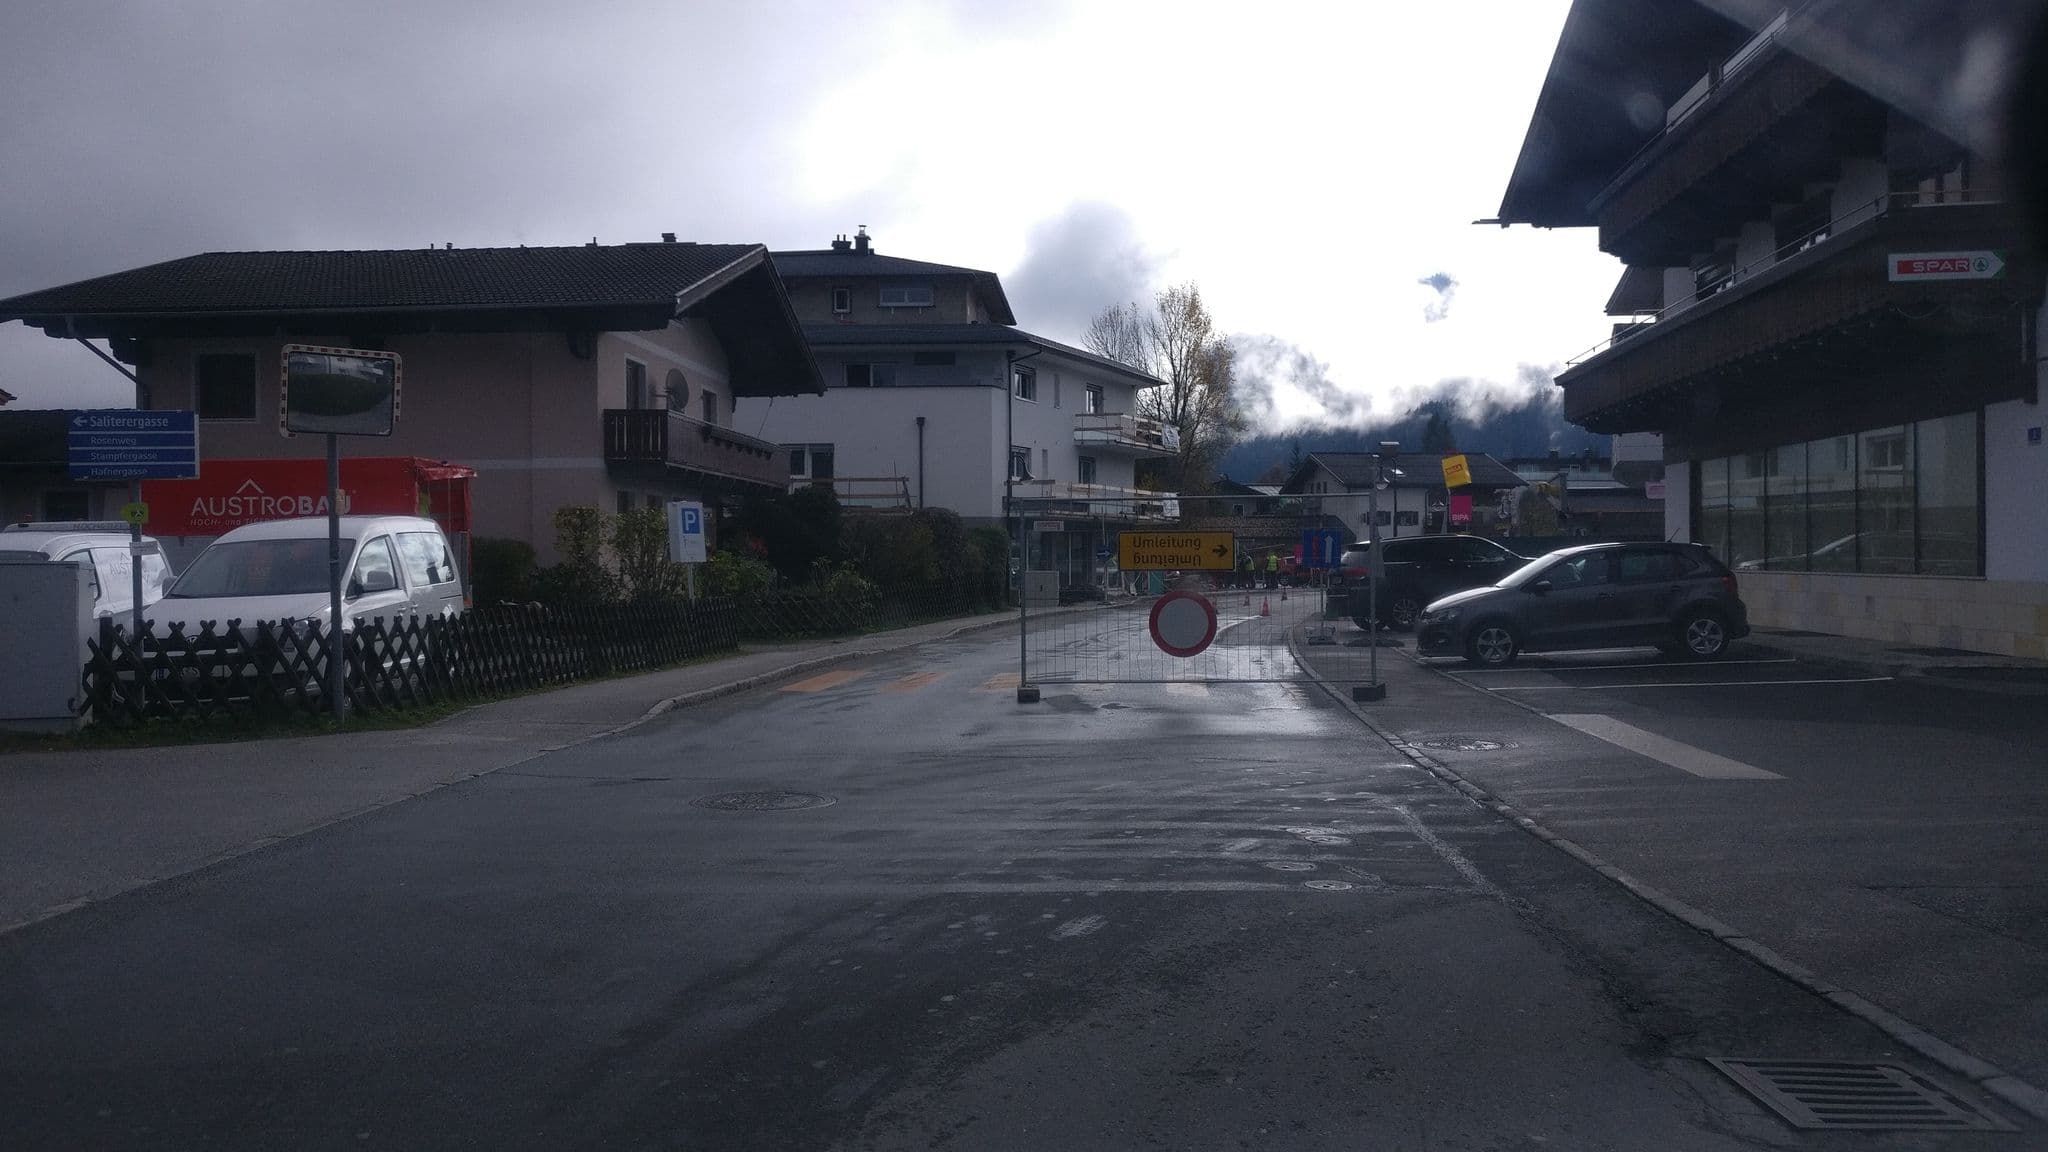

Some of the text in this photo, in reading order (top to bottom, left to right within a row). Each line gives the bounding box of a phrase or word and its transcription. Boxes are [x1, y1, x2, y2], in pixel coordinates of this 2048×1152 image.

[1912, 260, 1969, 273] SPAR
[89, 415, 169, 429] Saliterergasse
[90, 436, 137, 447] Rosenweg
[90, 450, 158, 462] Stampfergasse
[90, 467, 148, 478] Hafnergasse
[685, 511, 696, 531] P
[1132, 535, 1201, 550] Umleitung
[1132, 552, 1201, 567] Umleitung
